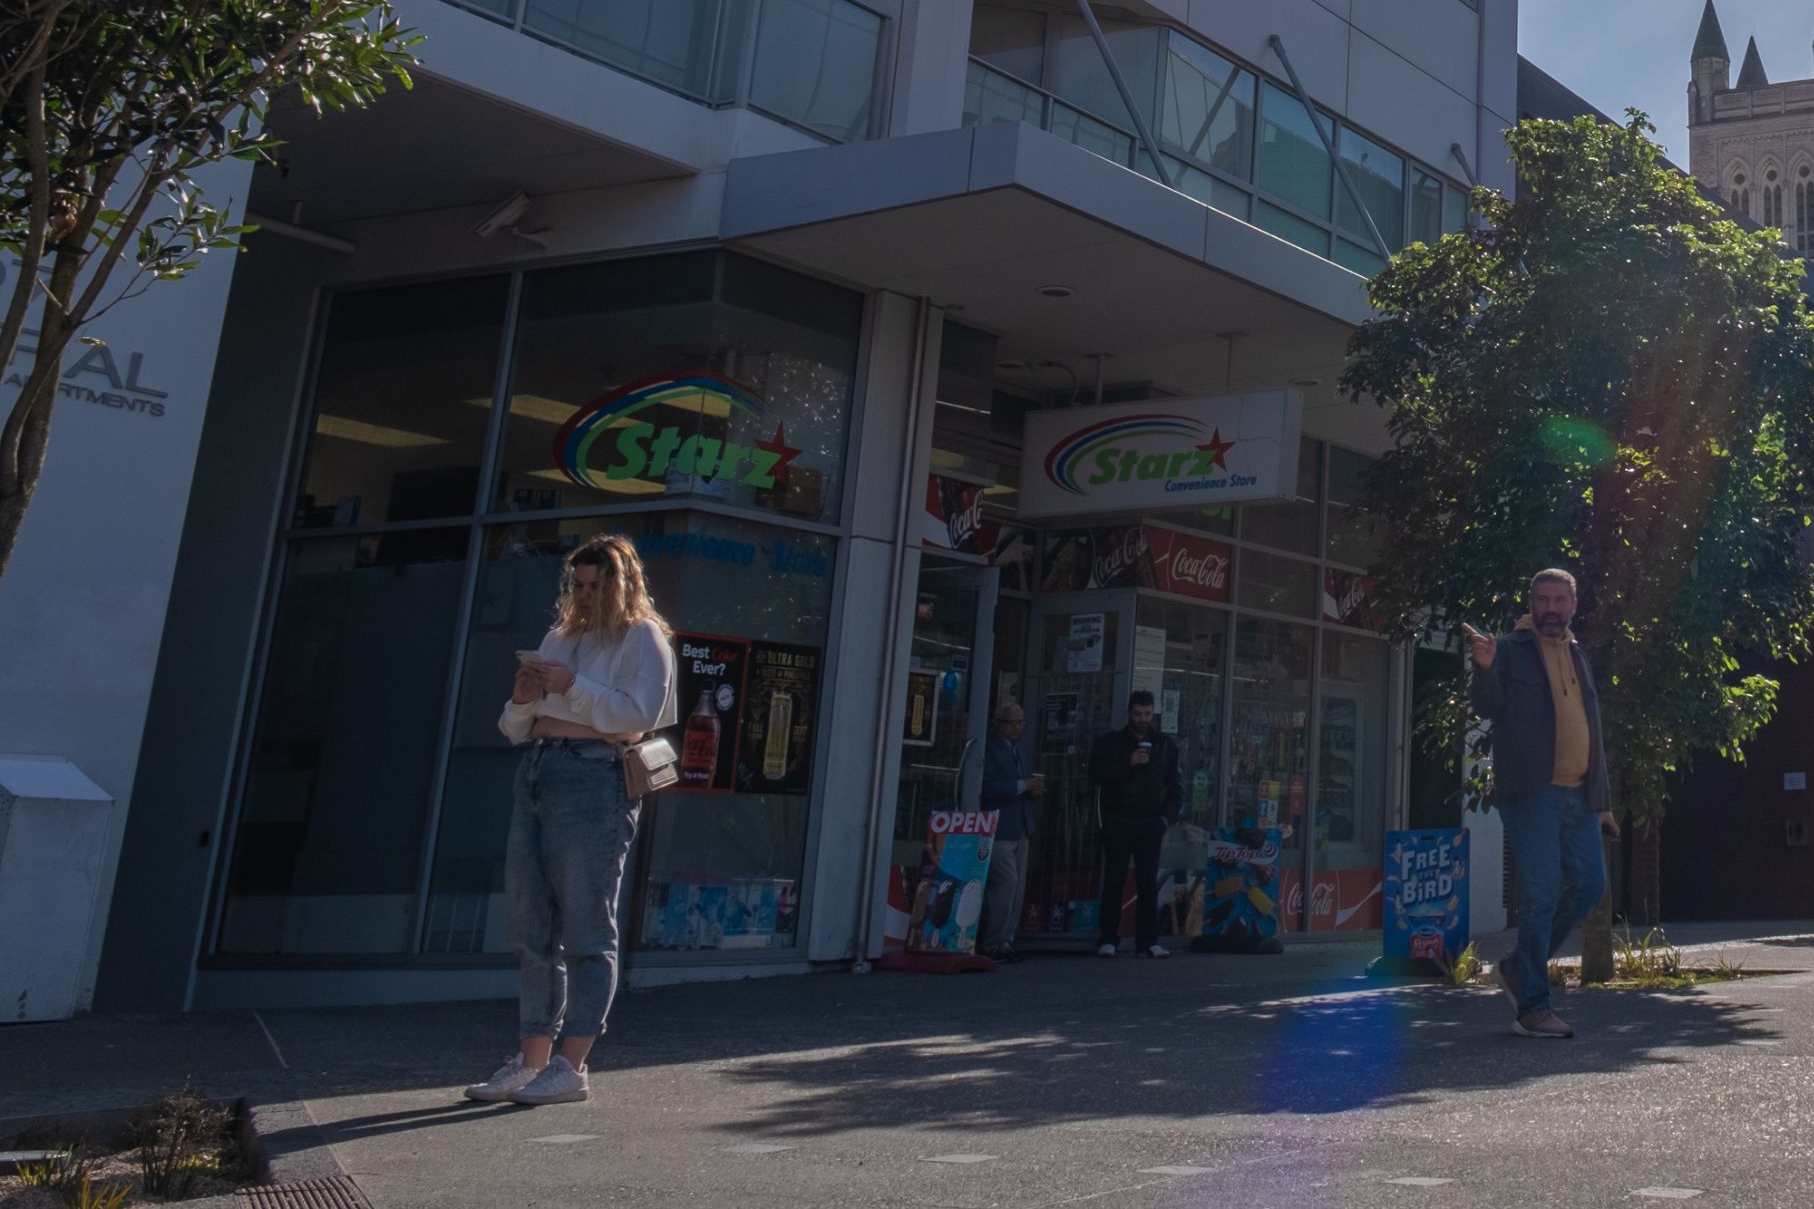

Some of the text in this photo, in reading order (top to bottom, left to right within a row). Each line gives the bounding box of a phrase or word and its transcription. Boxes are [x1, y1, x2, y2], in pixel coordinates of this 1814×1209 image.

[4, 372, 165, 417] ARTMENTS
[605, 422, 783, 489] Starz
[1088, 447, 1218, 485] Starz
[1164, 473, 1257, 493] Convenience Store
[682, 643, 710, 659] Best
[692, 660, 726, 676] Ever?
[931, 812, 994, 833] OPEN
[1402, 844, 1450, 881] FREE
